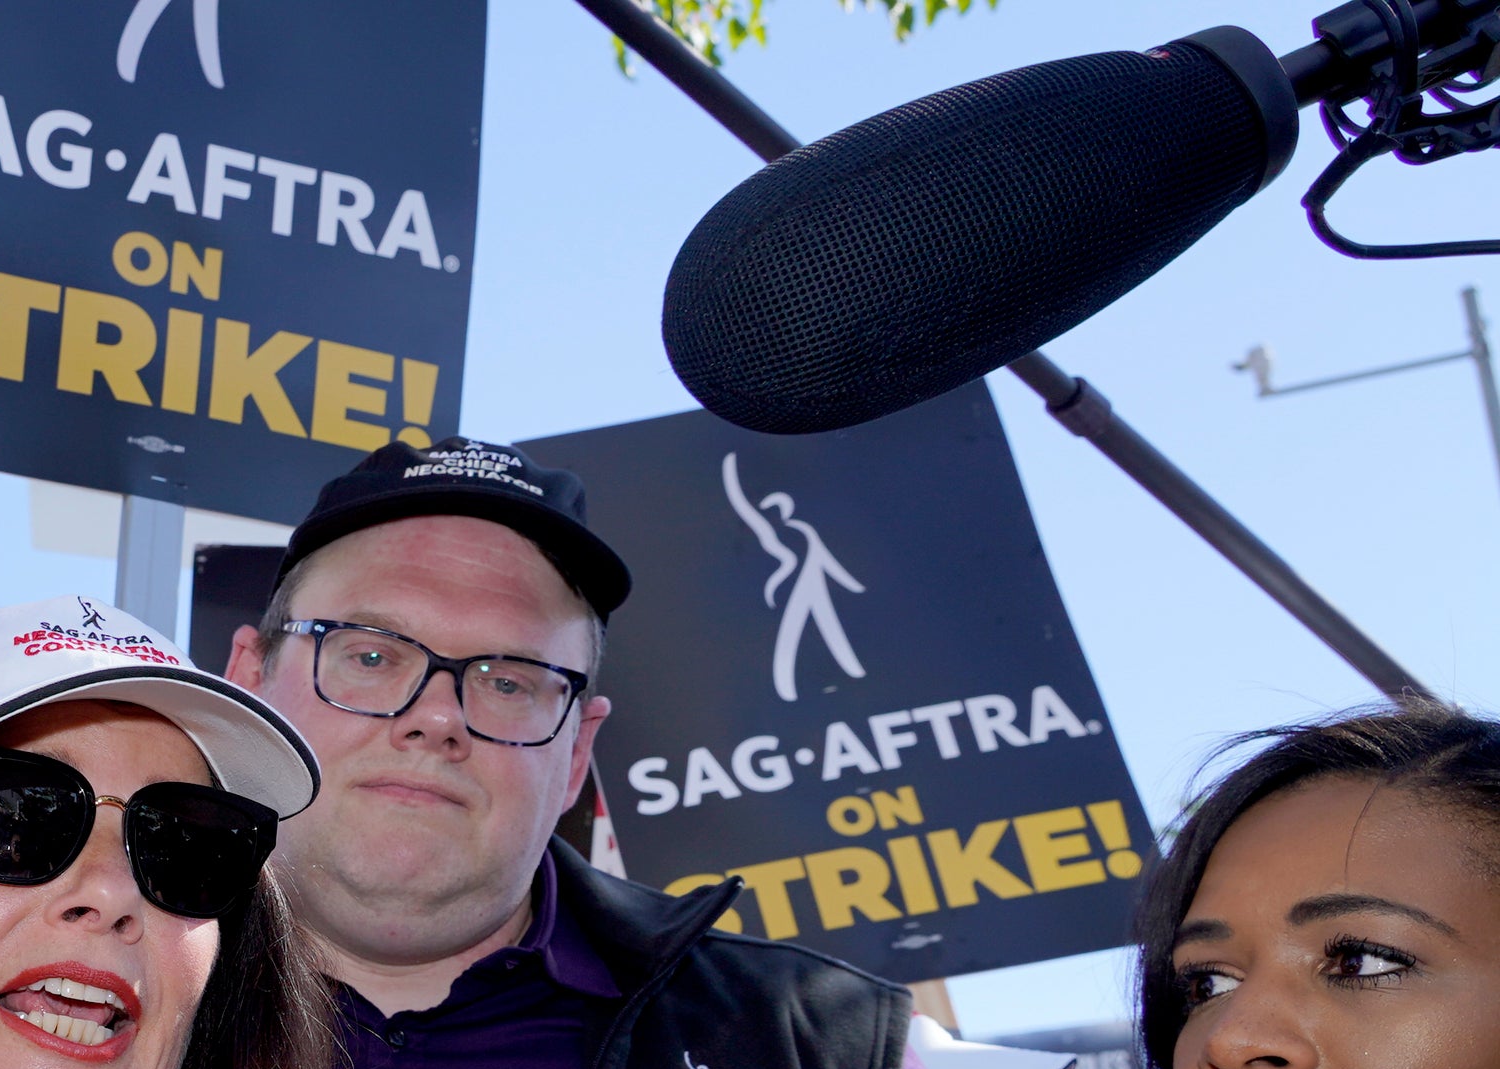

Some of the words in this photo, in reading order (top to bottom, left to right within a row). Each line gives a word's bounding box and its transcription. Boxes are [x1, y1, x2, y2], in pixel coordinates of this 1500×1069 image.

[112, 232, 223, 301] ON
[403, 463, 544, 497] NEGOTIATOR
[443, 458, 509, 472] CHIEF
[826, 787, 924, 837] ON
